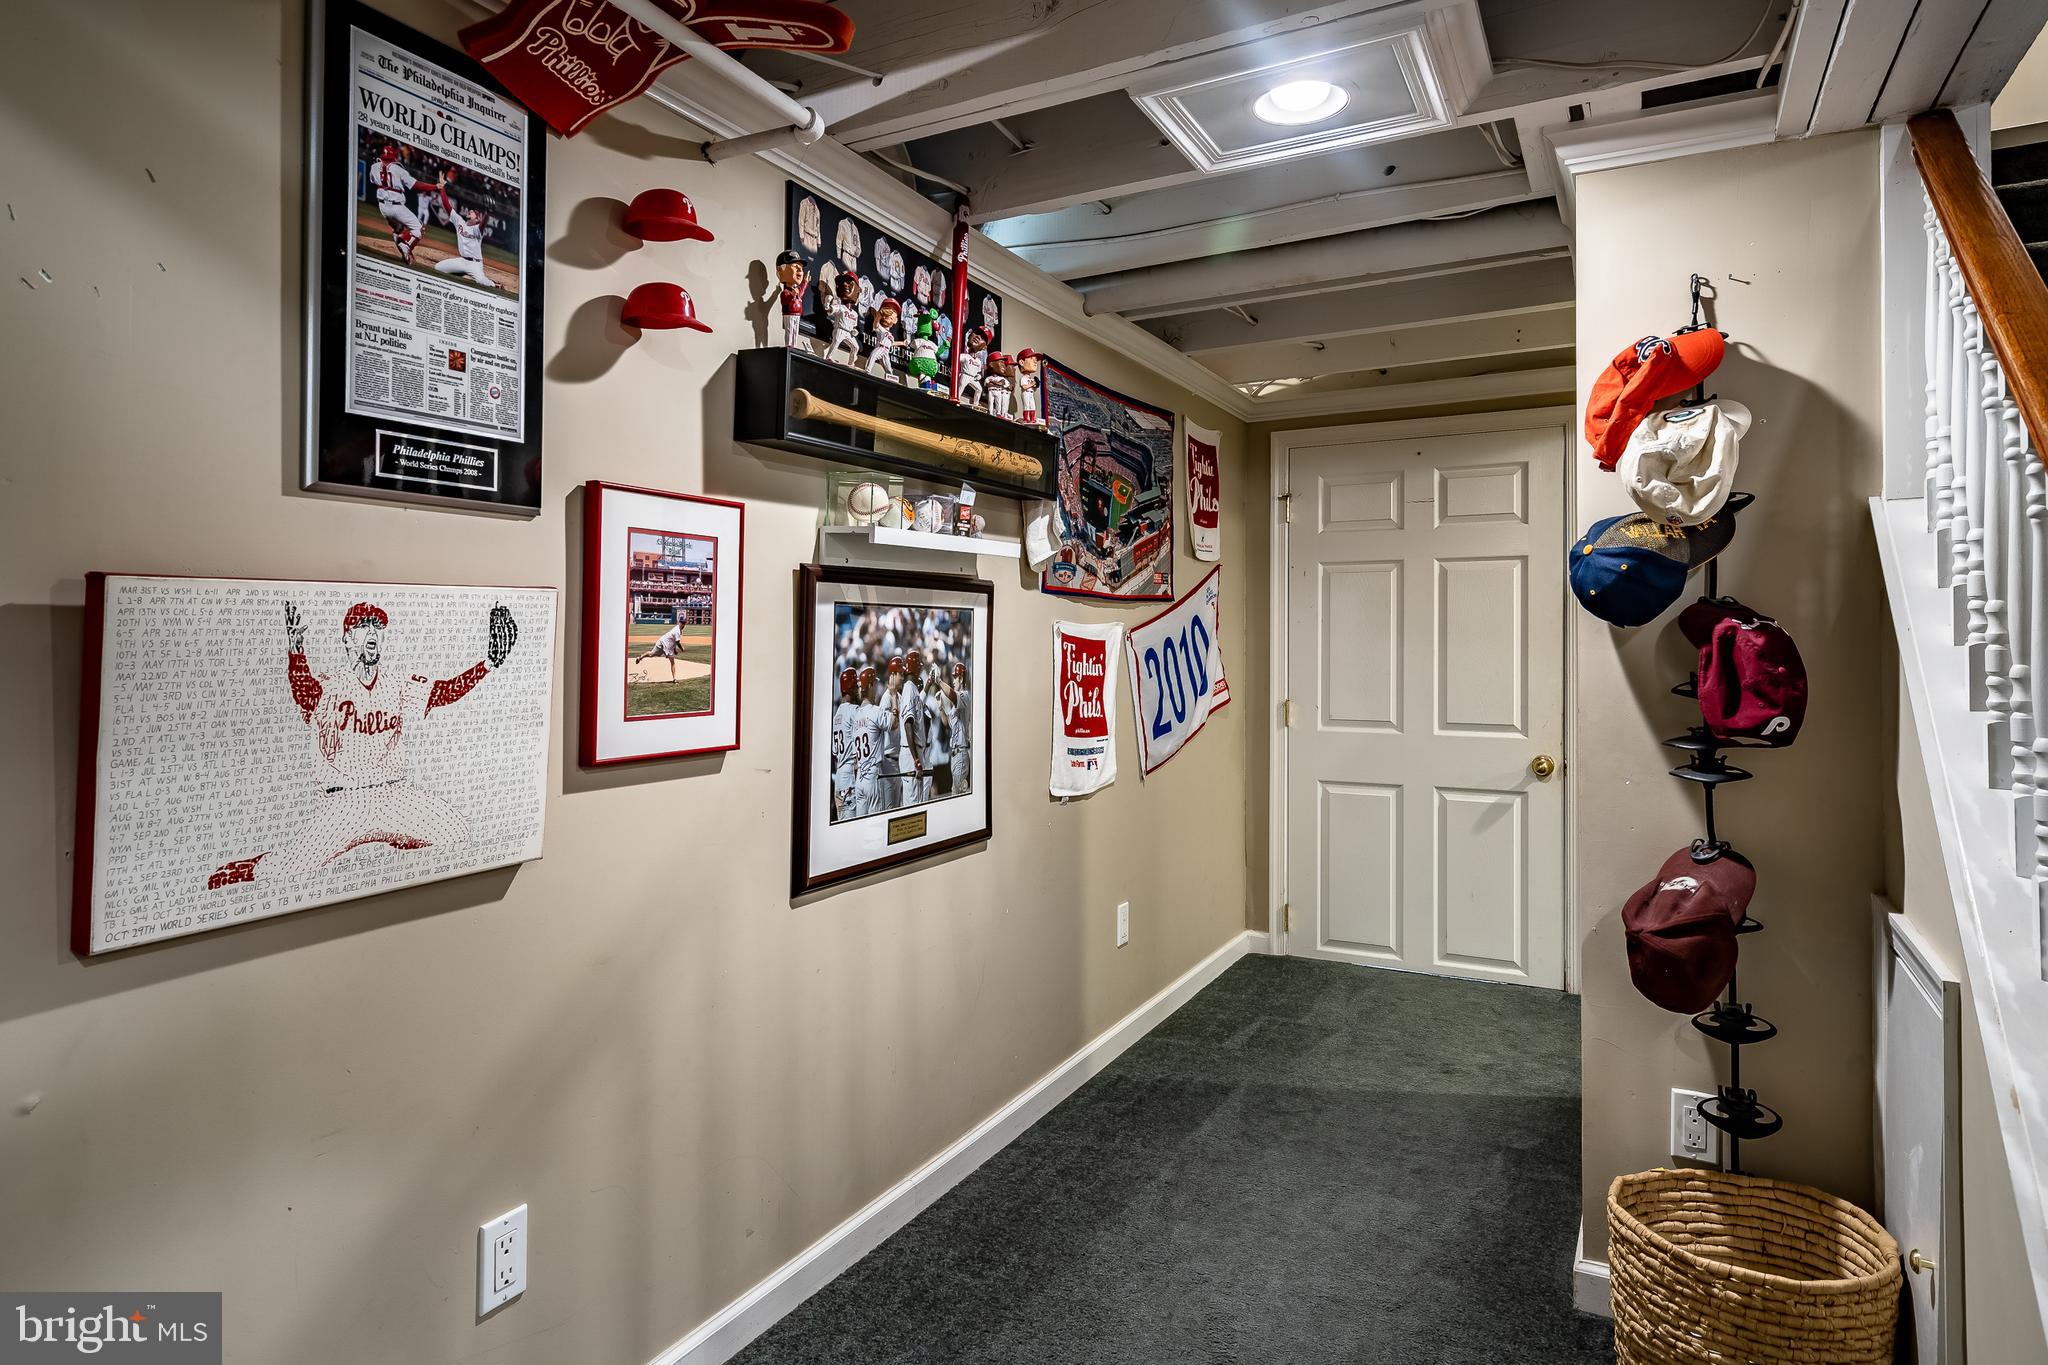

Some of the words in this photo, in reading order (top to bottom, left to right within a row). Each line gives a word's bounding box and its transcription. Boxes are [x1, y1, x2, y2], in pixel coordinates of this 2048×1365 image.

[526, 26, 606, 105] Phillies
[377, 55, 399, 74] The
[403, 65, 465, 105] Philadelphia
[467, 95, 506, 123] Inquirer
[358, 86, 436, 136] WORLD
[440, 123, 521, 172] CHAMPS!
[357, 110, 369, 122] 28
[369, 116, 391, 133] years
[392, 123, 411, 142] later,
[412, 131, 440, 152] Phillies
[440, 145, 460, 161] again
[461, 155, 473, 164] are
[473, 157, 505, 178] baseball's
[506, 171, 520, 184] best
[682, 197, 693, 214] P
[957, 232, 968, 262] Phillies
[422, 285, 442, 297] season
[443, 290, 449, 299] of
[449, 292, 463, 303] glory
[469, 299, 488, 311] capped
[496, 306, 518, 318] euphoria
[680, 291, 690, 317] P
[355, 319, 381, 334] Bryant
[382, 326, 398, 337] trial
[399, 330, 413, 341] hits
[355, 332, 363, 340] at
[363, 333, 379, 344] N.J.
[380, 337, 407, 350] politics
[392, 444, 450, 462] Philadelphia
[452, 453, 485, 467] Phillies
[400, 459, 419, 468] World
[419, 462, 438, 471] Series
[439, 464, 463, 475] Champs
[463, 468, 478, 477] 2008
[1190, 476, 1219, 514] Phils
[119, 586, 138, 595] MAR
[160, 587, 170, 595] VS
[174, 587, 192, 595] WSH
[226, 588, 240, 596] APR
[149, 596, 166, 605] APR
[170, 597, 185, 605] 7TH
[187, 597, 198, 605] AT
[240, 598, 253, 606] APR
[1144, 613, 1210, 741] 2010
[833, 729, 844, 756] 53
[855, 732, 870, 761] 33
[103, 920, 116, 930] TB
[152, 909, 172, 921] OCT
[175, 904, 197, 916] 25TH
[201, 899, 226, 911] WORLD
[229, 895, 254, 906] SERIES
[257, 891, 268, 900] GM
[279, 886, 287, 895] VS
[290, 883, 300, 893] TB
[326, 876, 341, 886] OCT
[362, 869, 381, 879] WORLD
[382, 863, 404, 875] SERIES
[404, 862, 413, 870] GM
[467, 849, 480, 858] OCT
[104, 910, 125, 920] NLCS
[151, 901, 165, 911] AT
[169, 897, 185, 908] LAD
[241, 877, 271, 894] SERIES
[104, 931, 130, 943] OCT
[132, 924, 156, 938] 29TH
[160, 917, 192, 931] WORLD
[196, 909, 228, 925] SERIES
[234, 907, 247, 917] GM
[262, 901, 271, 910] VS
[278, 896, 289, 907] TB
[309, 889, 322, 899] 4-3
[325, 878, 377, 896] PHILADELPHIA
[381, 871, 416, 885] PHILLIES
[418, 868, 431, 877] WIN
[434, 864, 451, 874] 2008
[453, 858, 477, 870] WORLD
